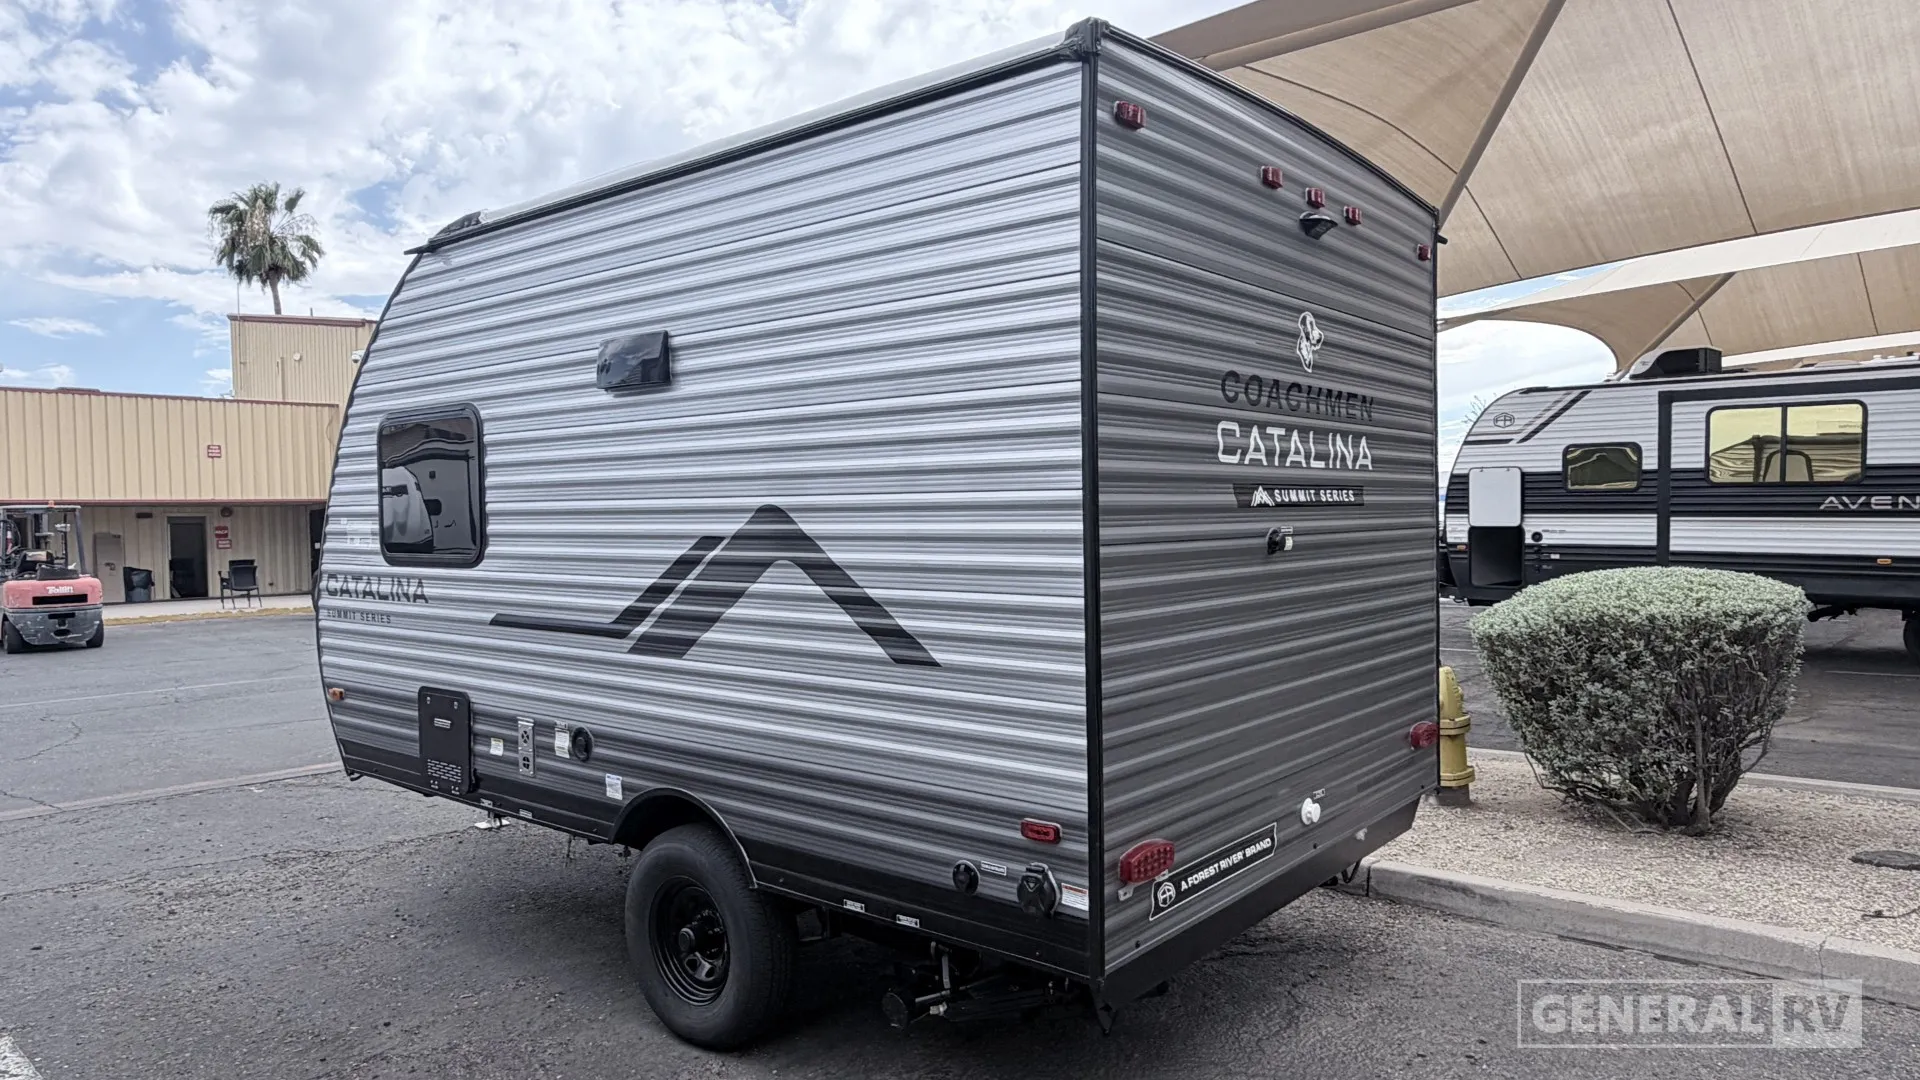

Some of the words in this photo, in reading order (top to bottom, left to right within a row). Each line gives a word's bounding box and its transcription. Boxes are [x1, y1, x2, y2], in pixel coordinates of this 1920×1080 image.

[1221, 370, 1374, 421] COACHMEN
[1217, 421, 1373, 470] CATALINA
[1274, 489, 1316, 502] SUMMIT
[1320, 489, 1355, 502] SERIES
[1819, 495, 1920, 510] AVEN
[326, 573, 429, 604] CATALINA
[327, 608, 356, 620] SUMMIT
[360, 611, 392, 624] SERIES
[1180, 880, 1189, 891] A
[1187, 863, 1221, 886] FOREST
[1245, 837, 1272, 857] BRAND
